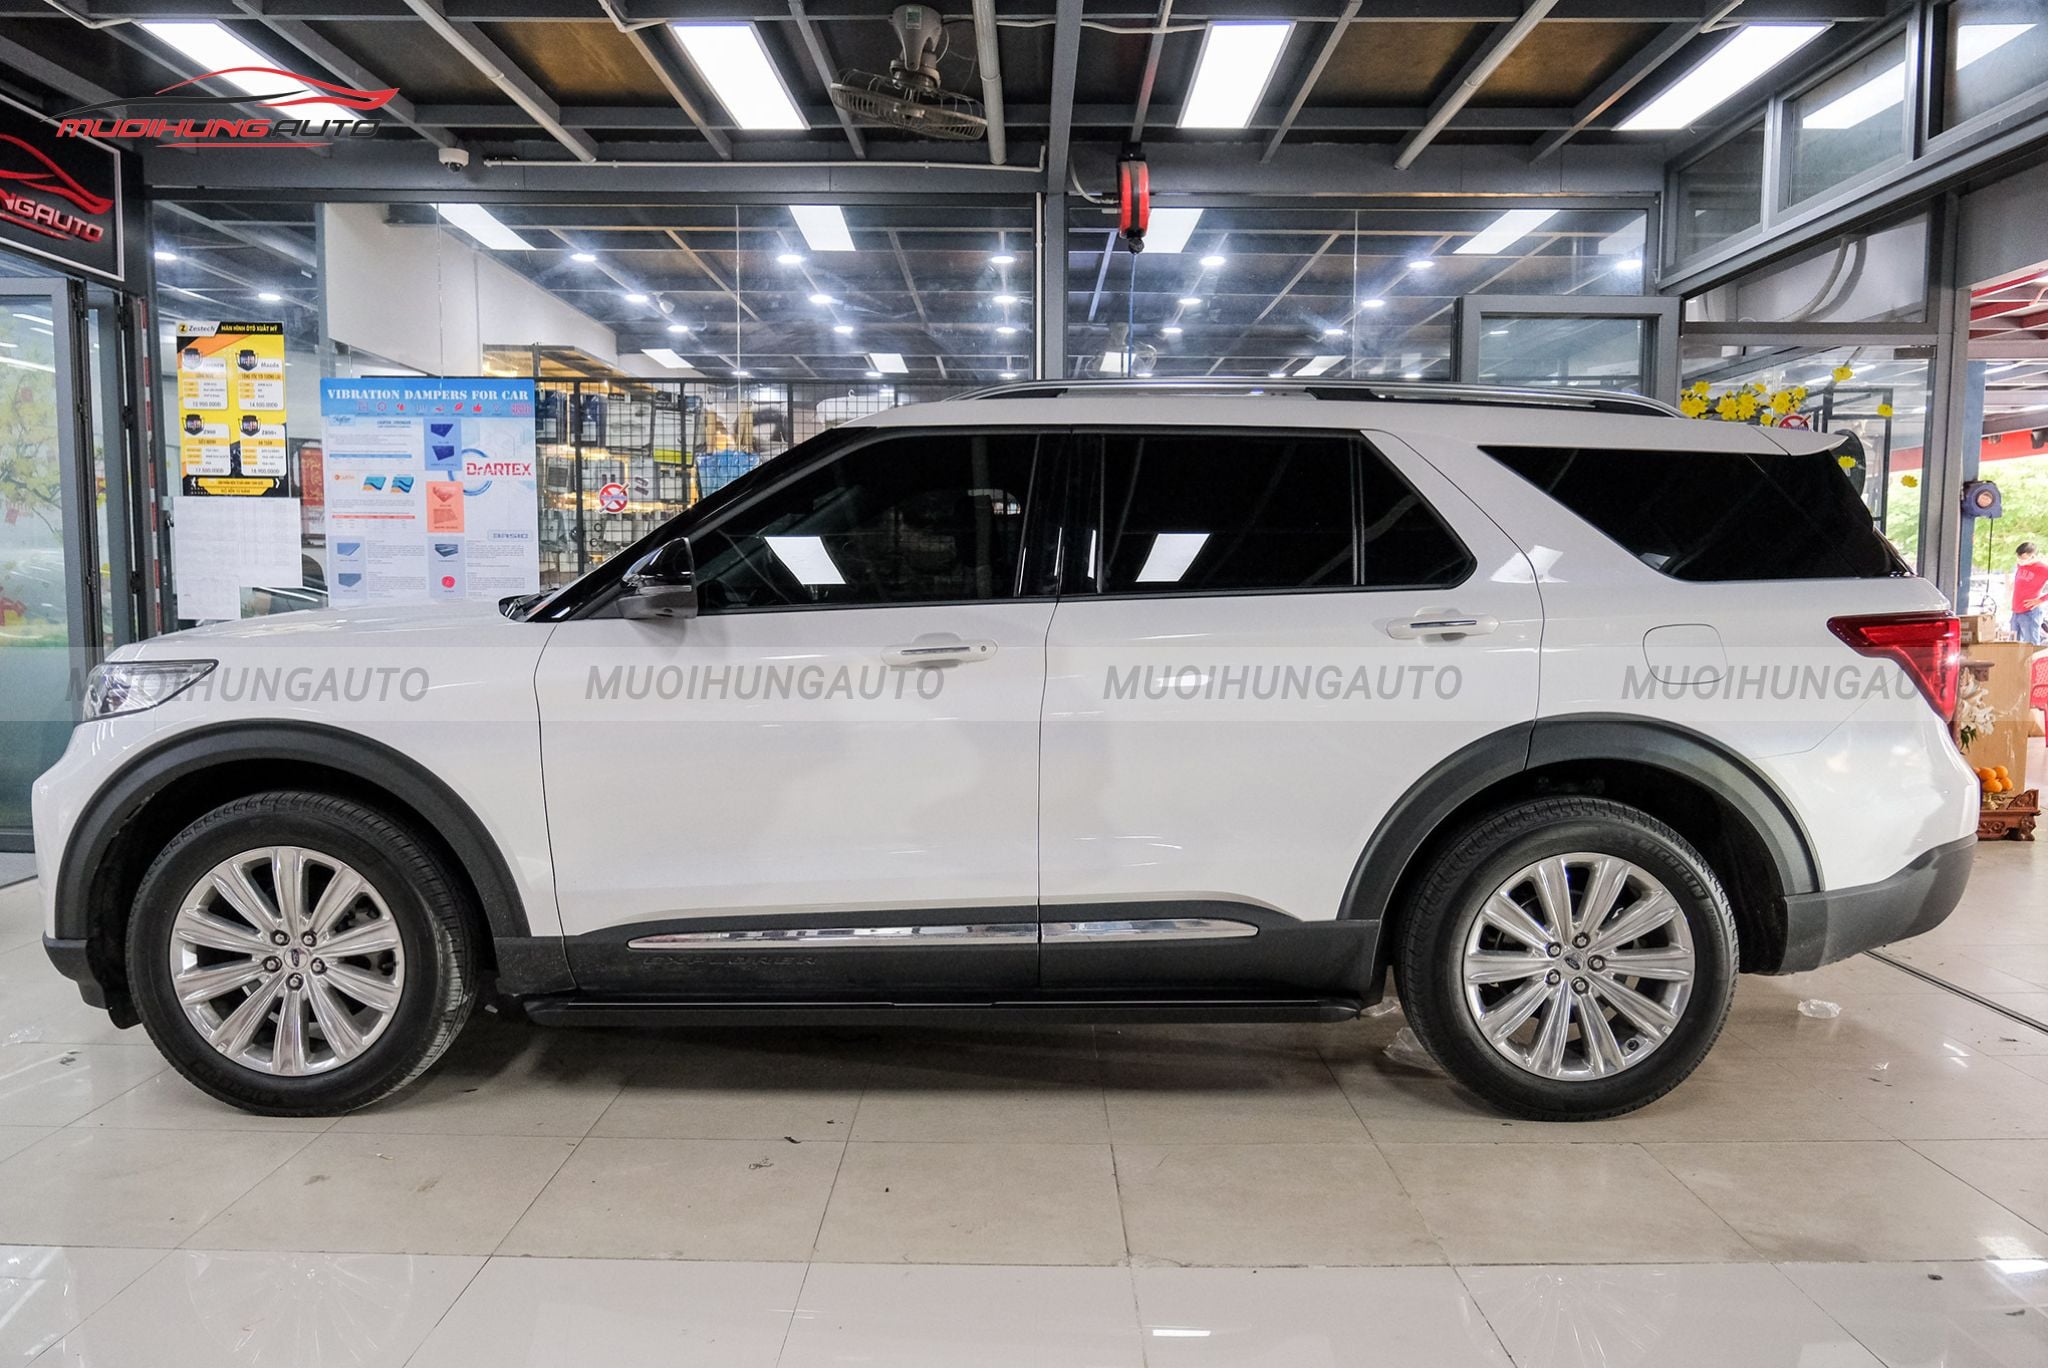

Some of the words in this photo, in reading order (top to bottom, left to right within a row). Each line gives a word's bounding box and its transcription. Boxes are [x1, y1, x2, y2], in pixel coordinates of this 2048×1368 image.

[328, 389, 400, 400] VIBRATION
[404, 390, 467, 400] DAMPERS
[472, 390, 498, 400] FOR
[501, 390, 528, 400] CAR
[466, 463, 532, 476] DrARTEX
